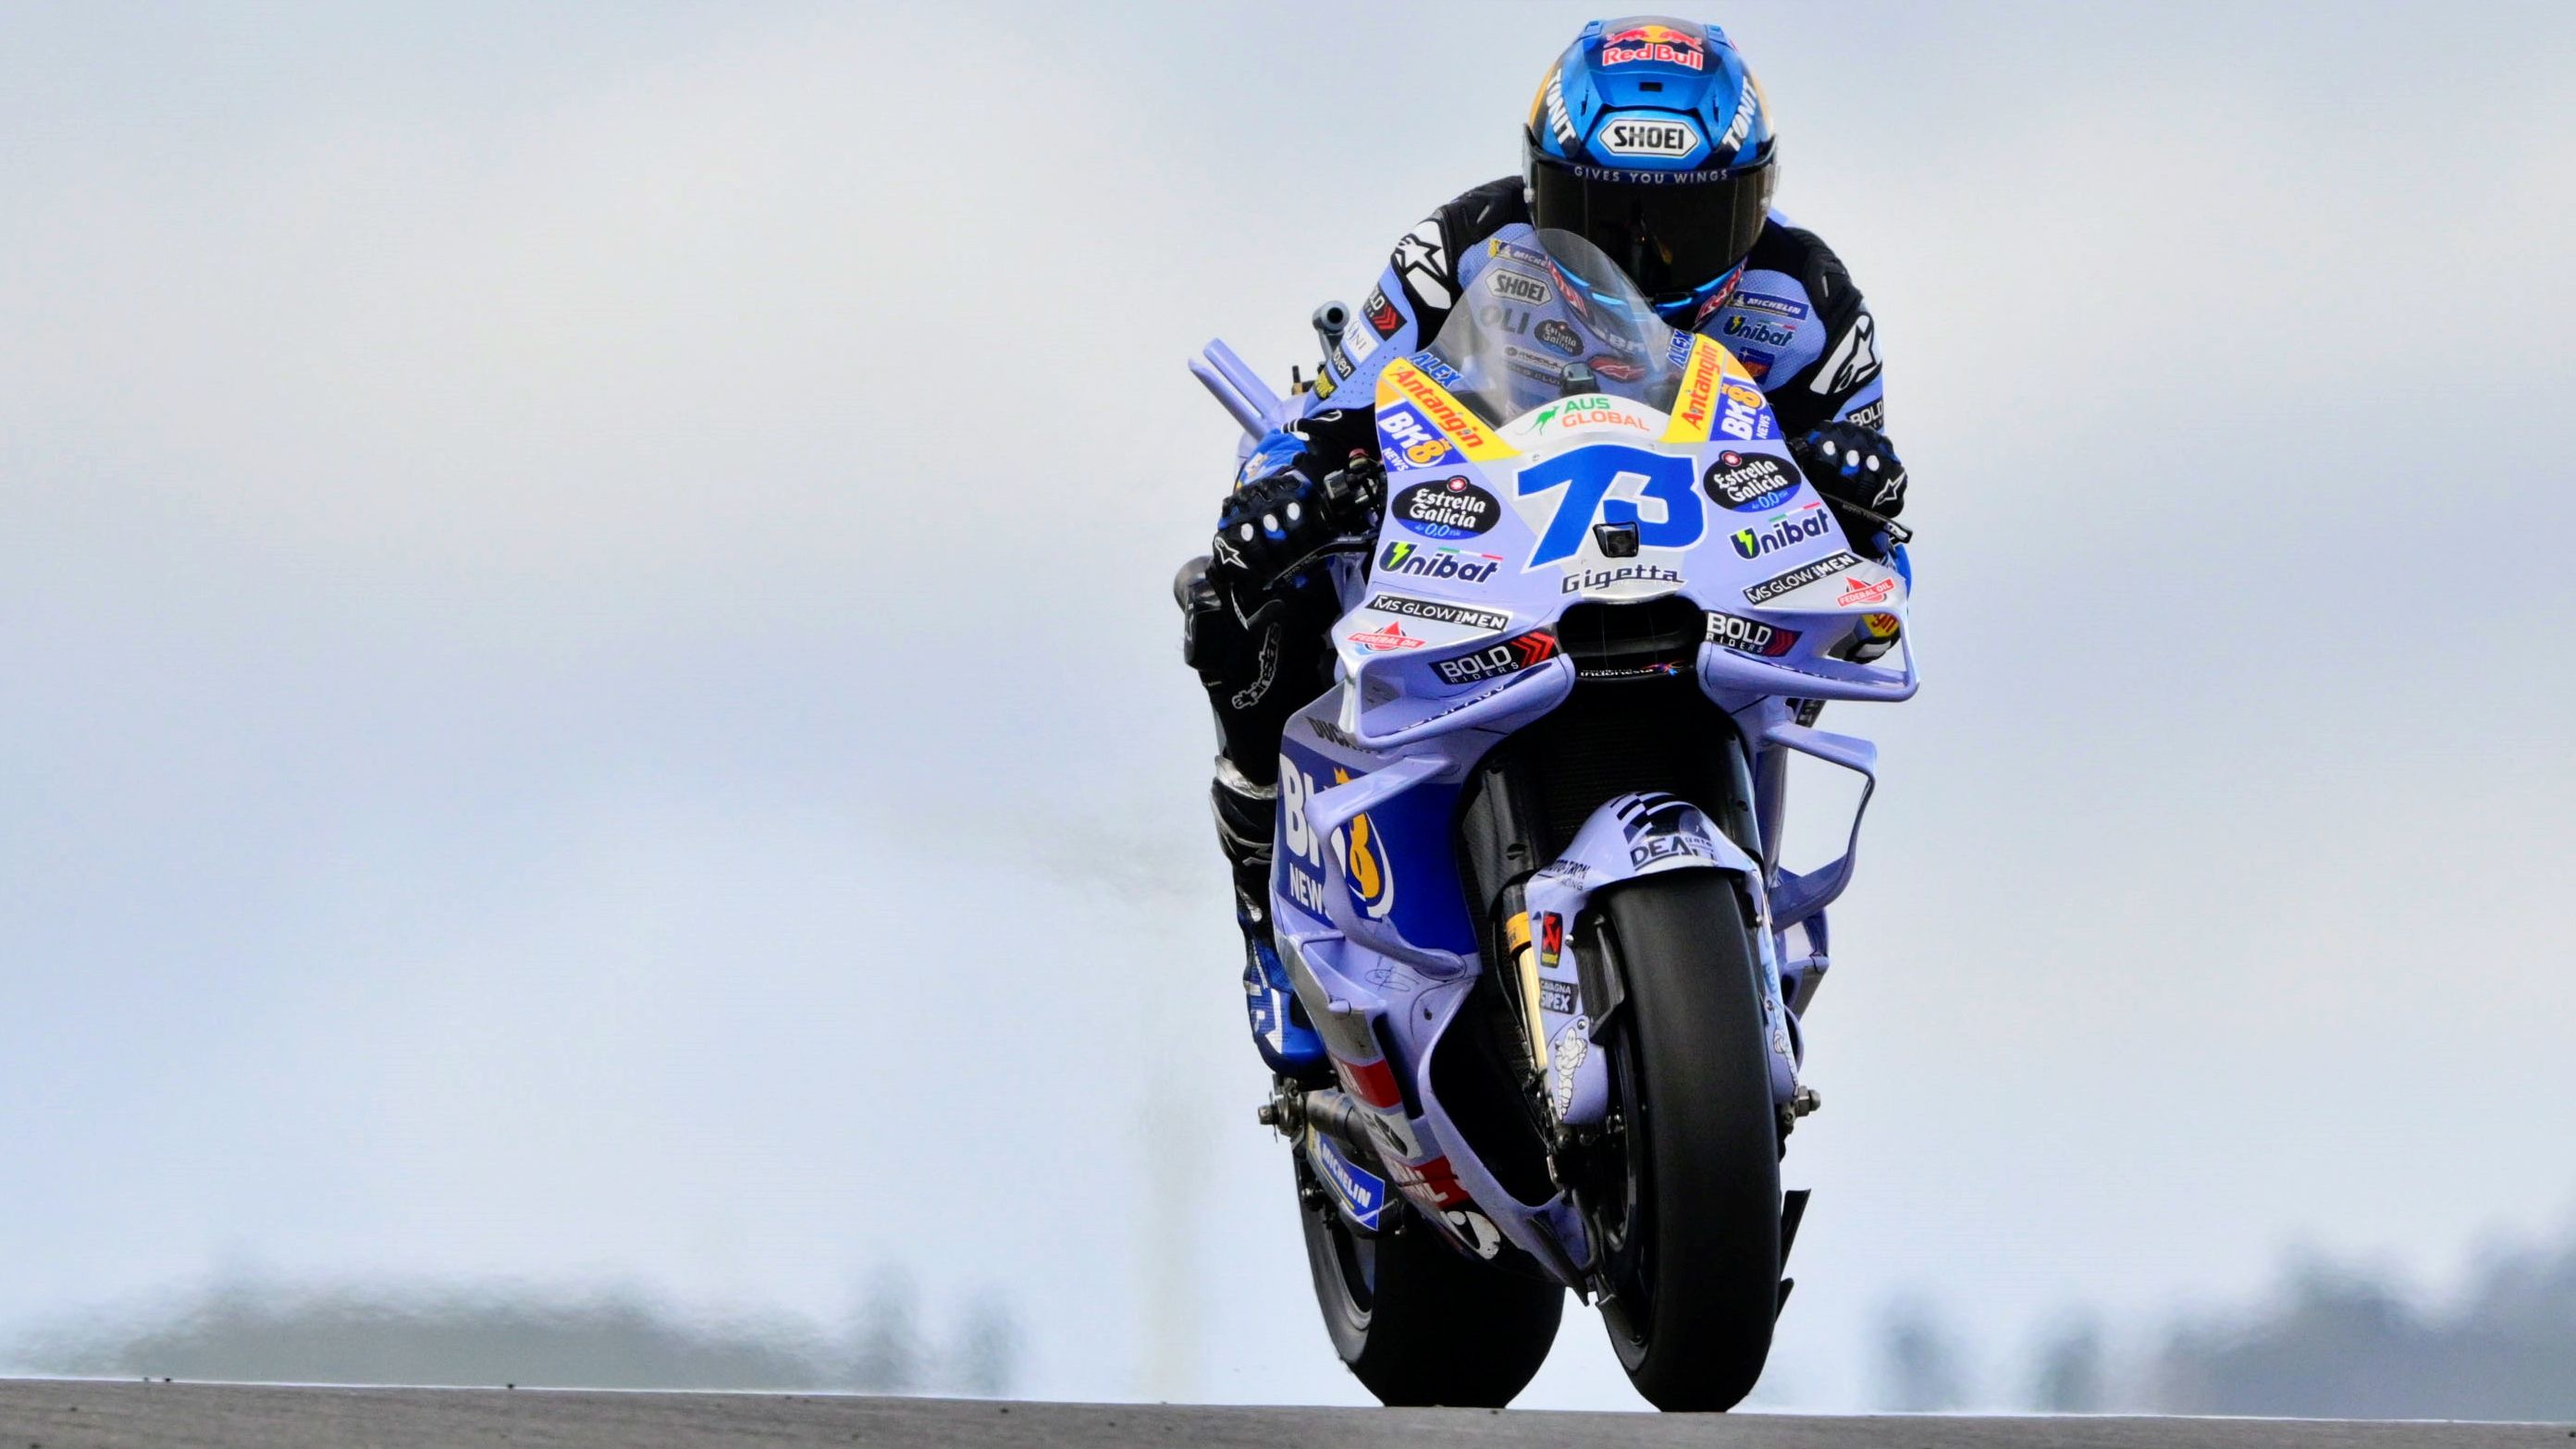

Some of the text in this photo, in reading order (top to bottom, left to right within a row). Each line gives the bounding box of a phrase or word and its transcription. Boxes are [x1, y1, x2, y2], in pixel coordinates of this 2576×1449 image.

[1603, 44, 1704, 70] Red Bull
[1614, 126, 1684, 150] SHOEI
[1574, 166, 1728, 184] GIVES YOU WINGS
[1495, 275, 1545, 301] SHOEI
[1747, 298, 1801, 314] MICHELIN
[1723, 315, 1793, 347] Unibat
[1666, 329, 1695, 369] ALEX
[1408, 352, 1463, 388] ALEX
[1681, 342, 1720, 431] Antangin
[1389, 370, 1484, 448] Antangin
[1564, 398, 1611, 413] AUS
[1721, 385, 1762, 441] BK8
[1850, 400, 1883, 426] BOLD
[1562, 411, 1650, 432] GLOBAL
[1756, 414, 1771, 439] NEWS
[1378, 411, 1446, 463] BK8
[1381, 448, 1410, 472] NEWS
[1714, 460, 1779, 489] Estrella
[1727, 474, 1788, 502] Galicia
[1412, 488, 1485, 514] Estrella
[1516, 444, 1706, 569] 73
[1410, 504, 1476, 529] Galicia
[1729, 510, 1830, 559] Unibat
[1378, 541, 1499, 583] Unibat
[1561, 565, 1686, 595] Gigetta
[1745, 586, 1772, 603] MS
[1770, 569, 1814, 593] GLOW
[1840, 583, 1892, 605] FEDERAL OIL
[1374, 596, 1401, 611] MS
[1402, 602, 1456, 620] GLOW
[1706, 632, 1764, 653] RIDERS
[1707, 612, 1772, 645] BOLD
[1439, 645, 1512, 677] BOLD
[1449, 662, 1518, 684] RIDERS
[1289, 863, 1332, 921] NEW
[1322, 1144, 1372, 1208] MICHELIN
